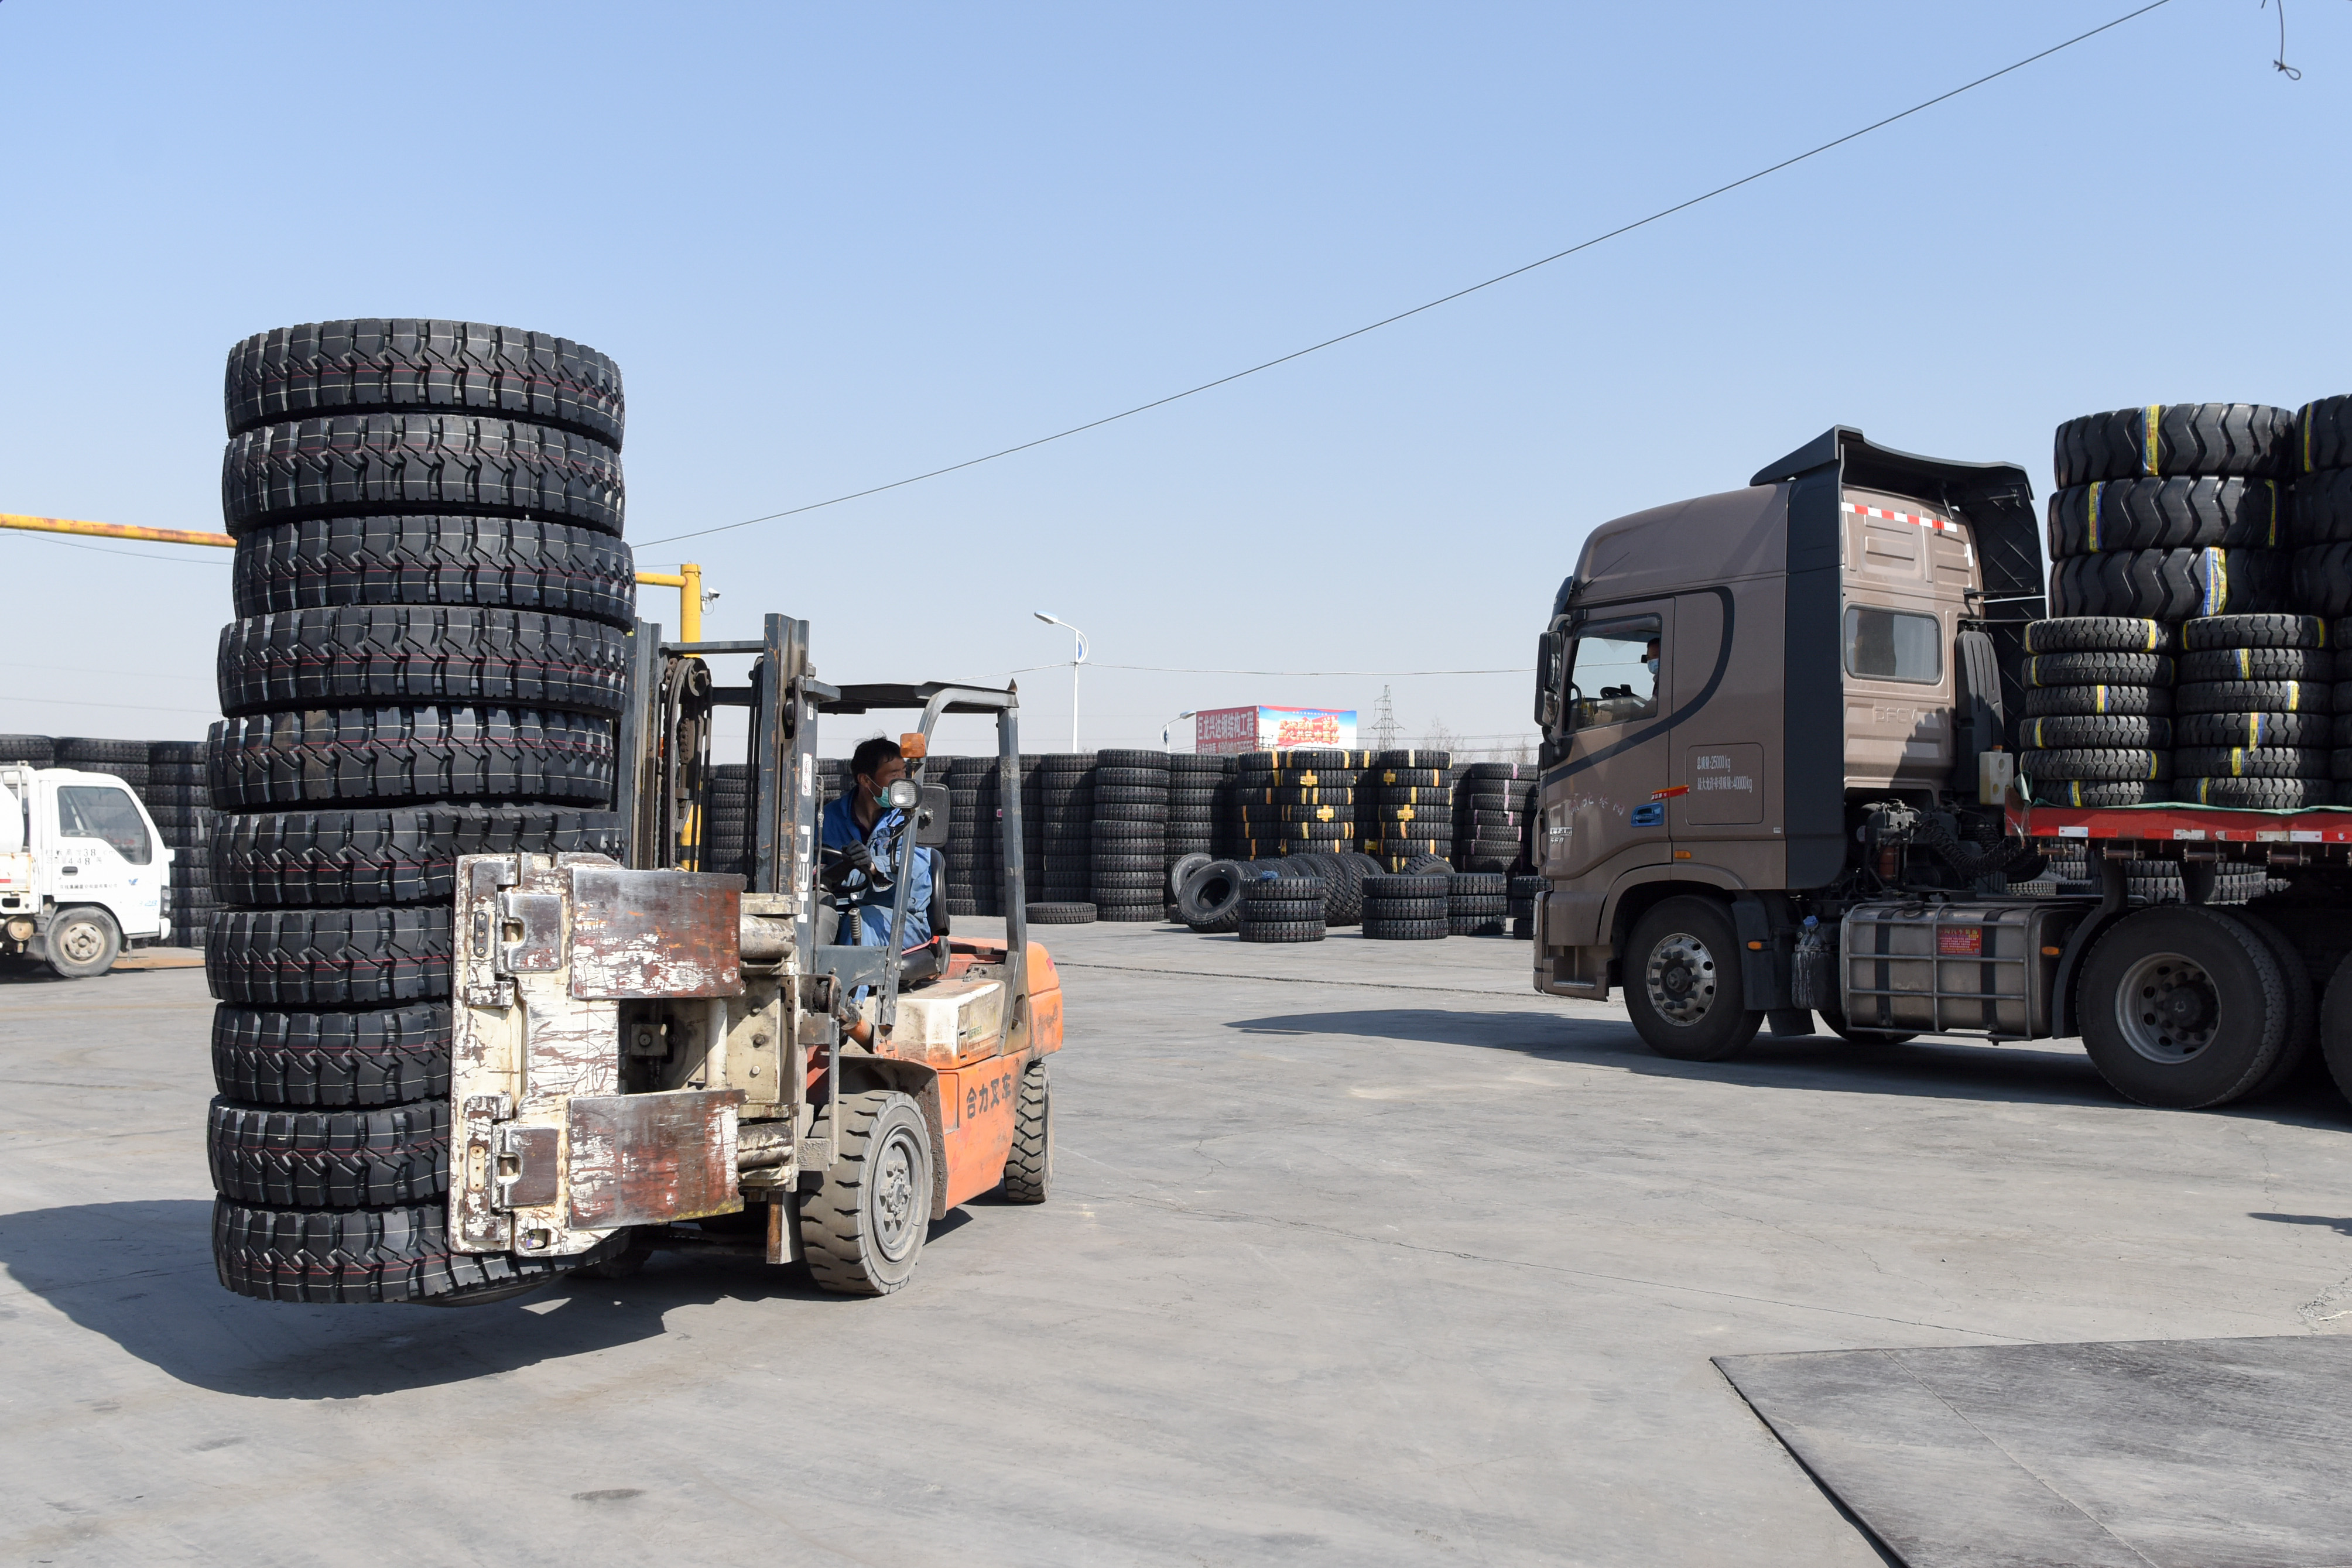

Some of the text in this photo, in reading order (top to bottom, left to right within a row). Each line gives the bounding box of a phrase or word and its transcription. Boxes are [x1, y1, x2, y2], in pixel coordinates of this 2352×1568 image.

[1197, 711, 1254, 740] 巨龙兴达钢结构工程
[1875, 706, 1915, 724] DFCV
[797, 825, 811, 923] HELI
[966, 1072, 1011, 1119] 合力叉车
